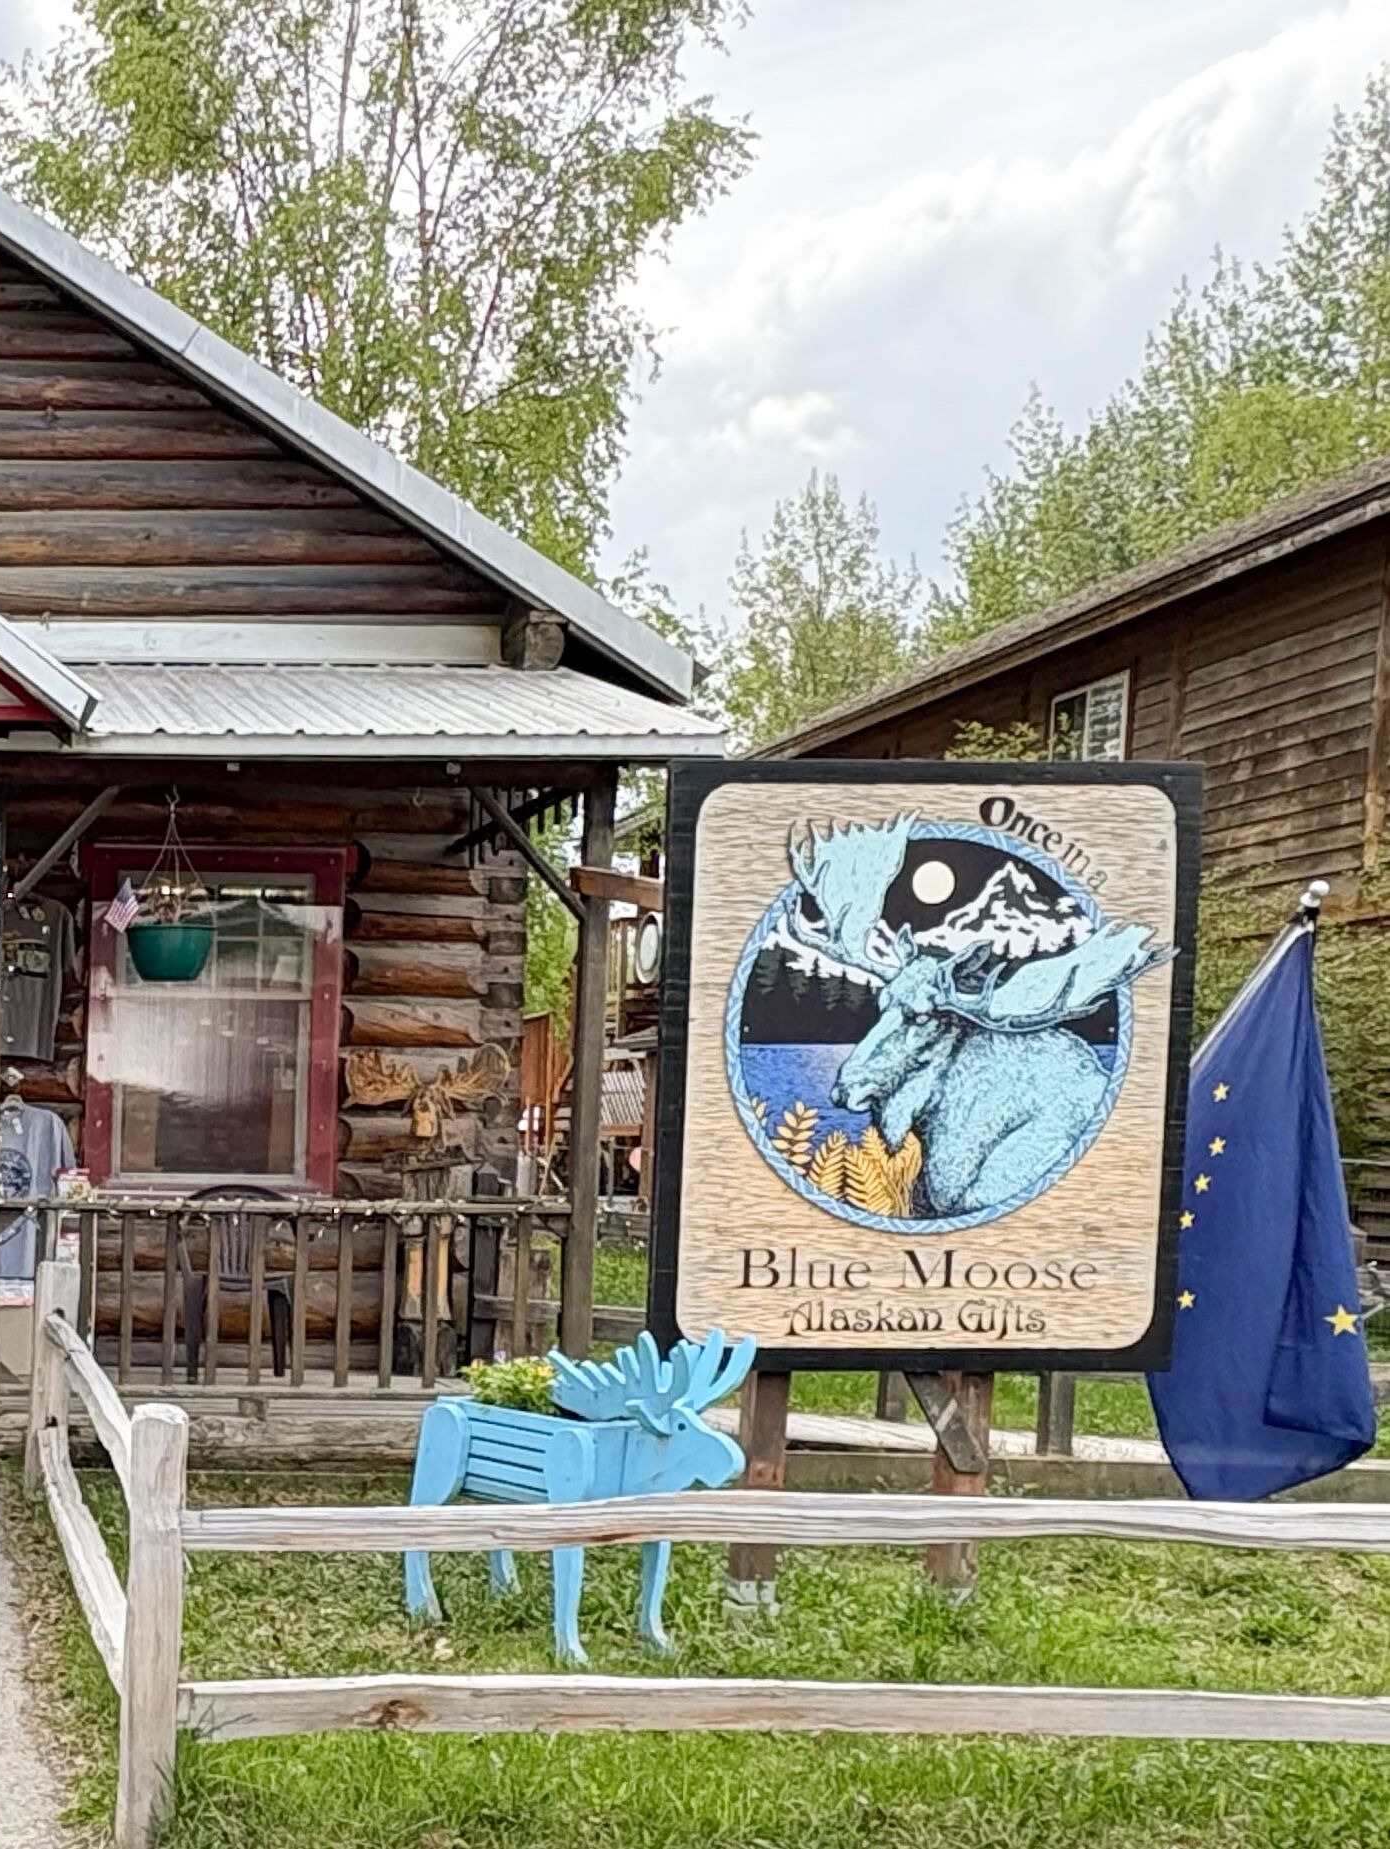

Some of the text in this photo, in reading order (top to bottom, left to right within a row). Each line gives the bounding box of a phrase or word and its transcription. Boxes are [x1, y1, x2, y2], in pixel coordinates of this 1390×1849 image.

[979, 796, 1109, 893] Once in a
[736, 1247, 1100, 1291] Blue Moose
[782, 1299, 1048, 1341] Alaskan Gifts
